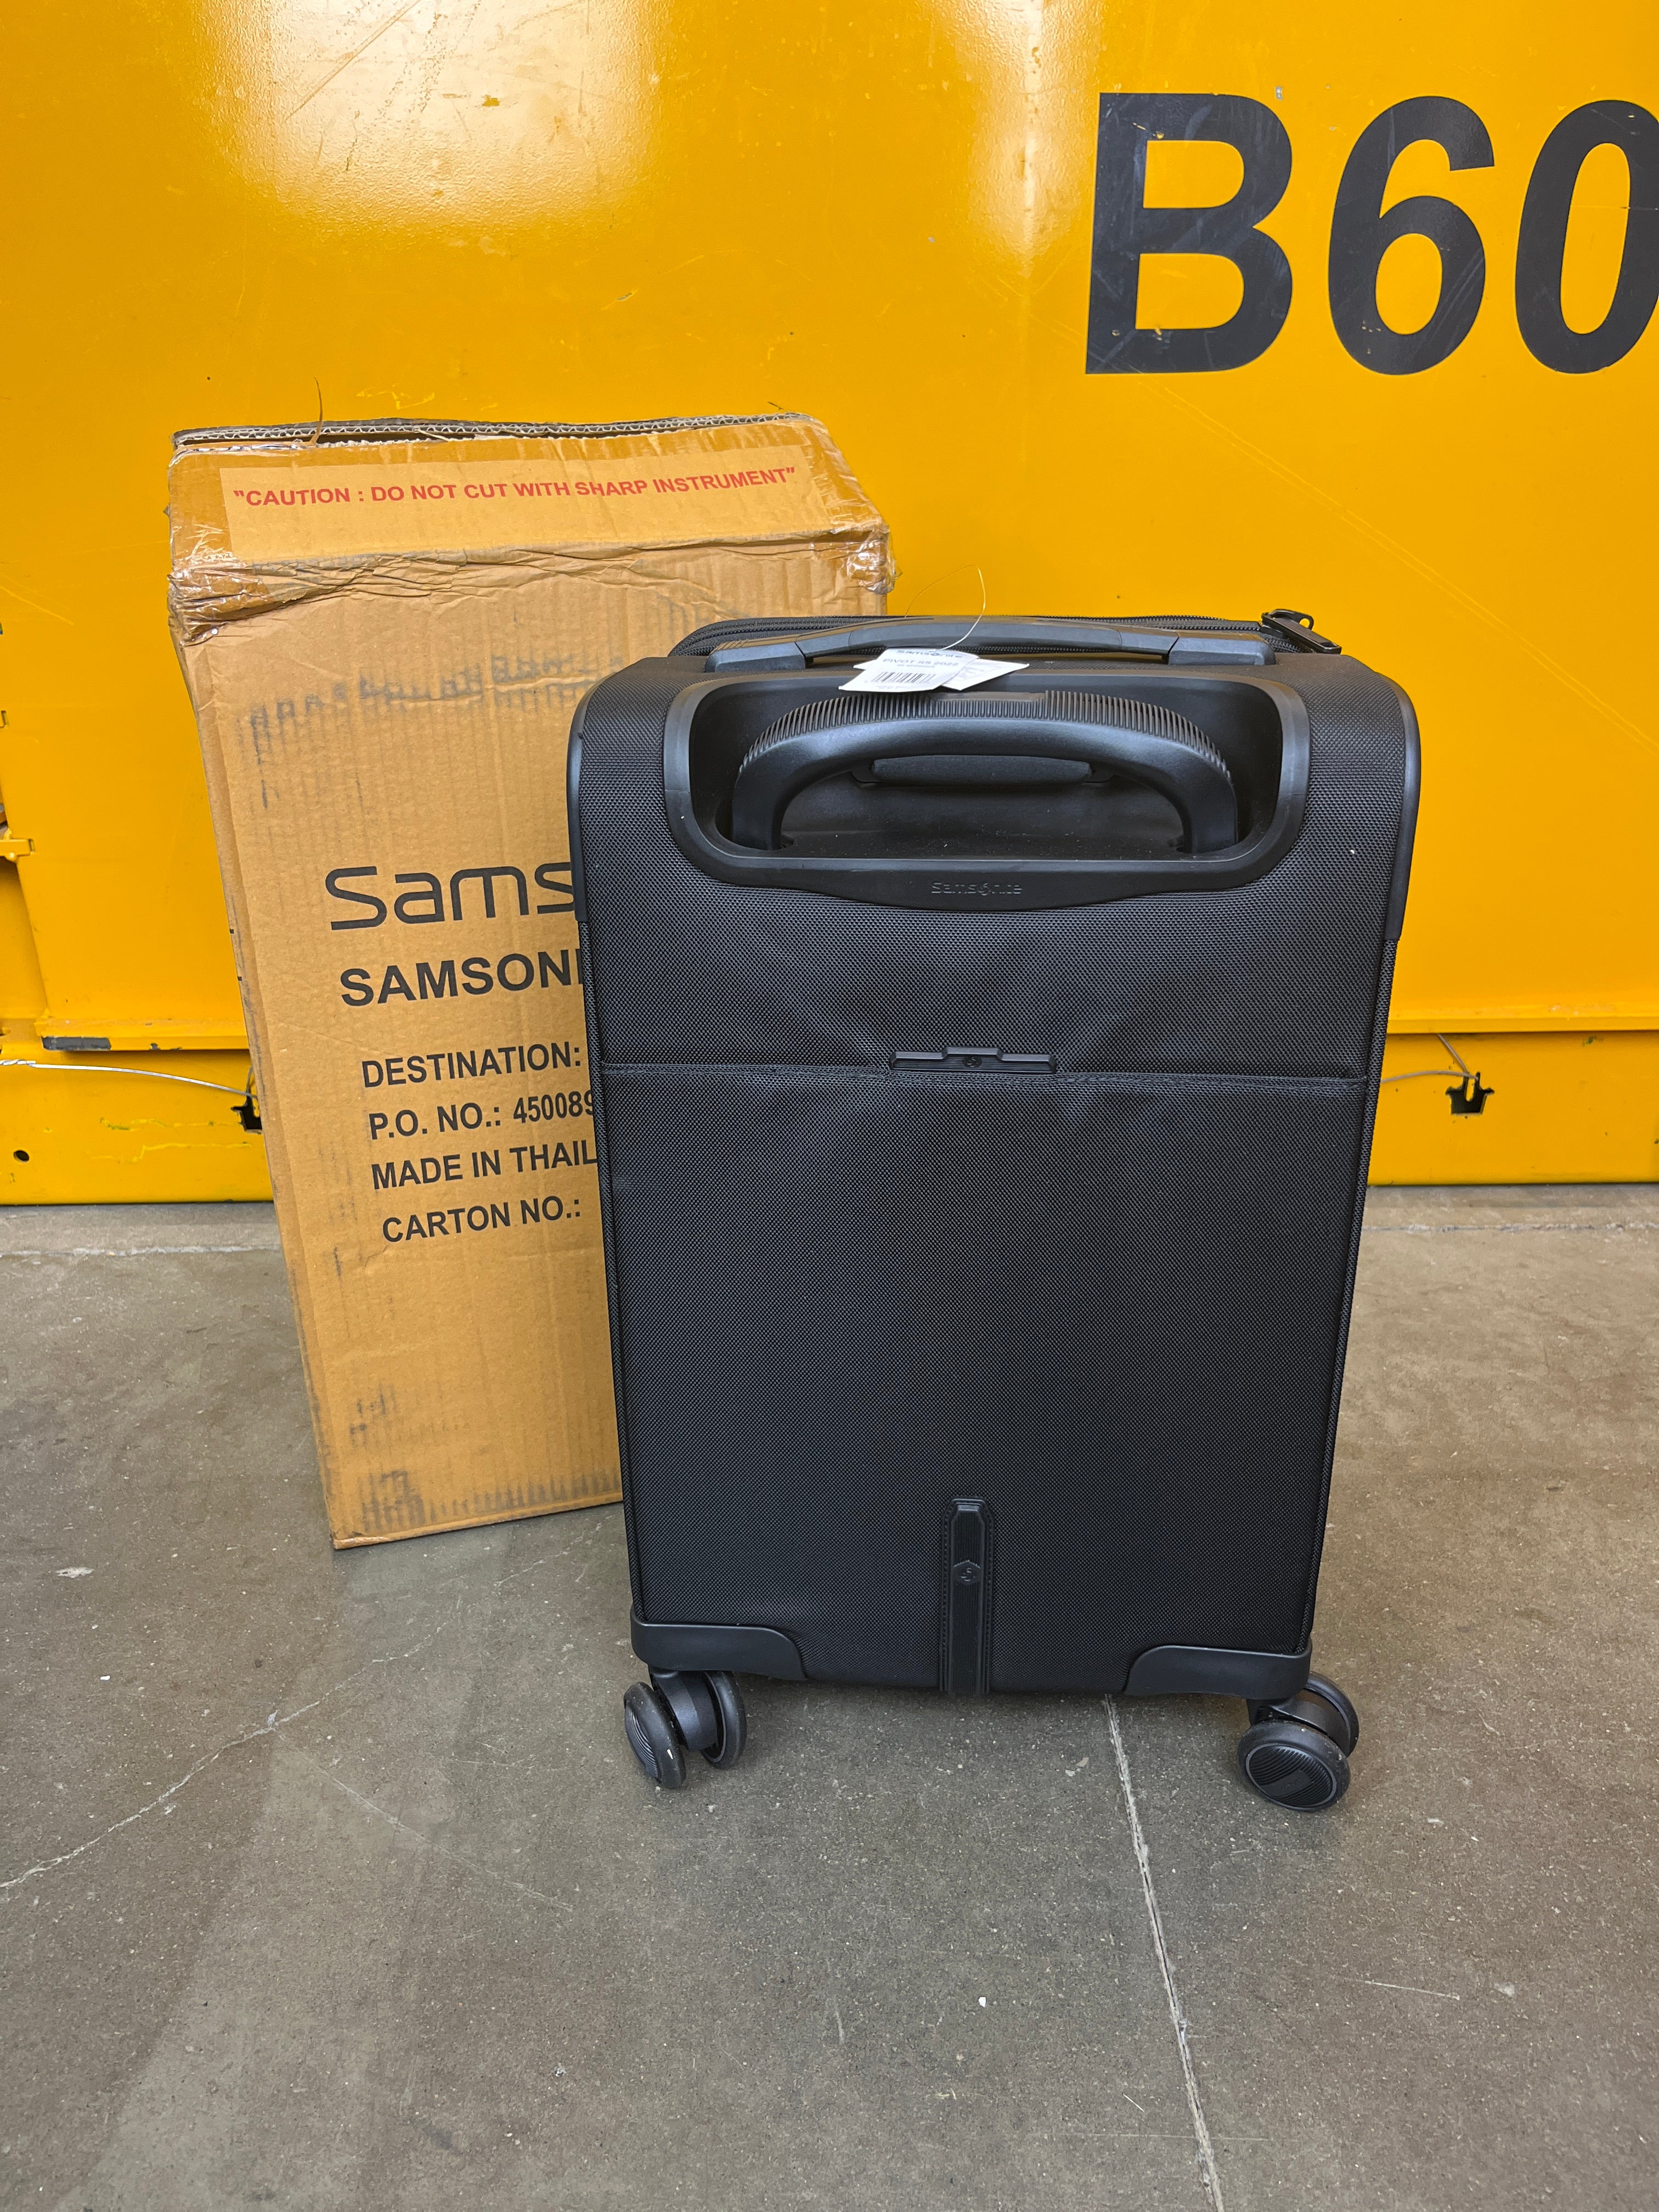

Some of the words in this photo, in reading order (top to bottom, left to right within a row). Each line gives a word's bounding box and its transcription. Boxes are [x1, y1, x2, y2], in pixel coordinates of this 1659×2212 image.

[1085, 92, 1659, 375] B60
[233, 488, 351, 506] "CAUTION
[370, 486, 405, 501] DO
[410, 484, 456, 500] NOT
[464, 483, 507, 499] CUT
[512, 482, 571, 496] WITH
[575, 479, 648, 496] SHARP
[652, 466, 795, 493] INSTRUMENT"
[362, 1041, 582, 1088] DESTINATION:
[369, 1109, 428, 1141] P.O.
[437, 1102, 501, 1133] NO.:
[371, 1154, 464, 1190] MADE
[471, 1149, 501, 1178] IN
[509, 1139, 598, 1172] THAIL
[382, 1201, 511, 1243] CARTON
[520, 1195, 581, 1225] NO.:
